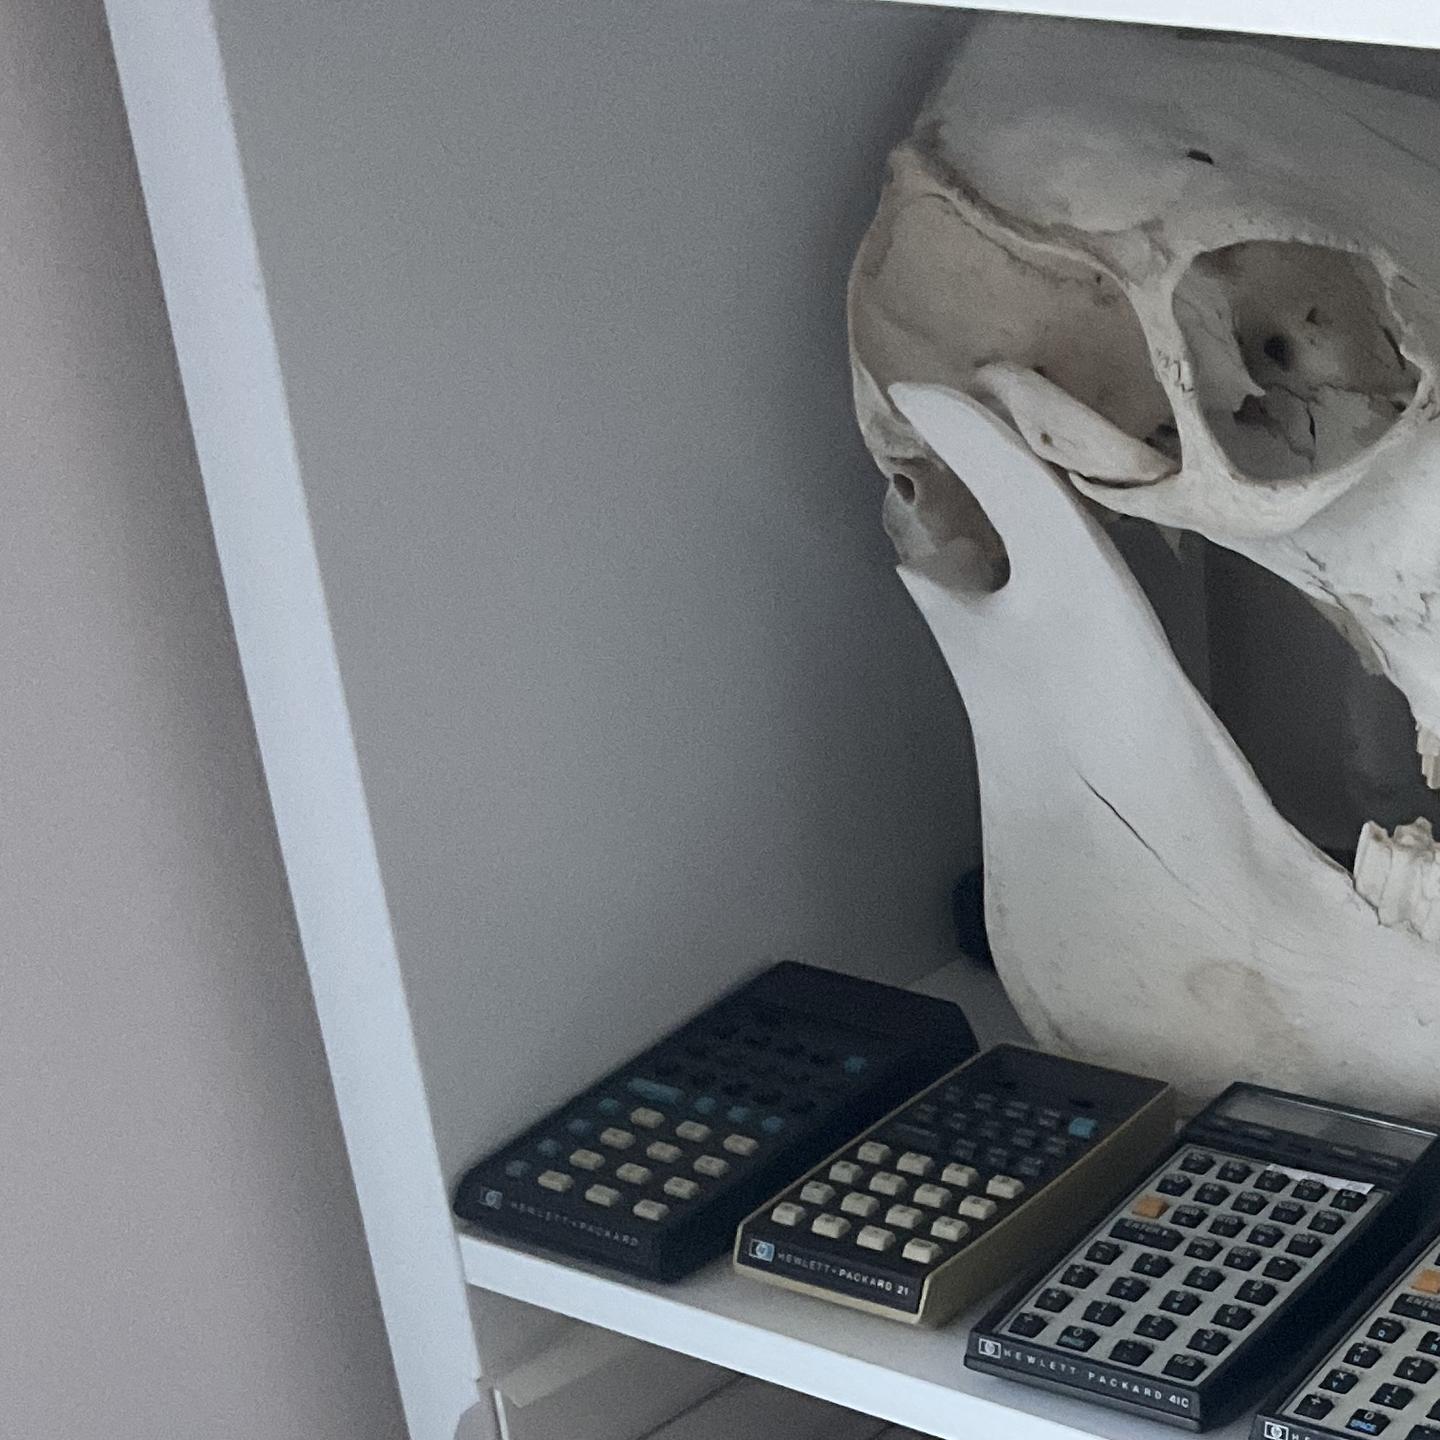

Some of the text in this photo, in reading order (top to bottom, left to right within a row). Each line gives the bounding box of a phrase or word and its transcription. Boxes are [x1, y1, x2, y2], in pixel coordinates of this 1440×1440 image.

[896, 1284, 910, 1297] 21
[1003, 1349, 1191, 1409] HEWLETT PACKARD 41C
